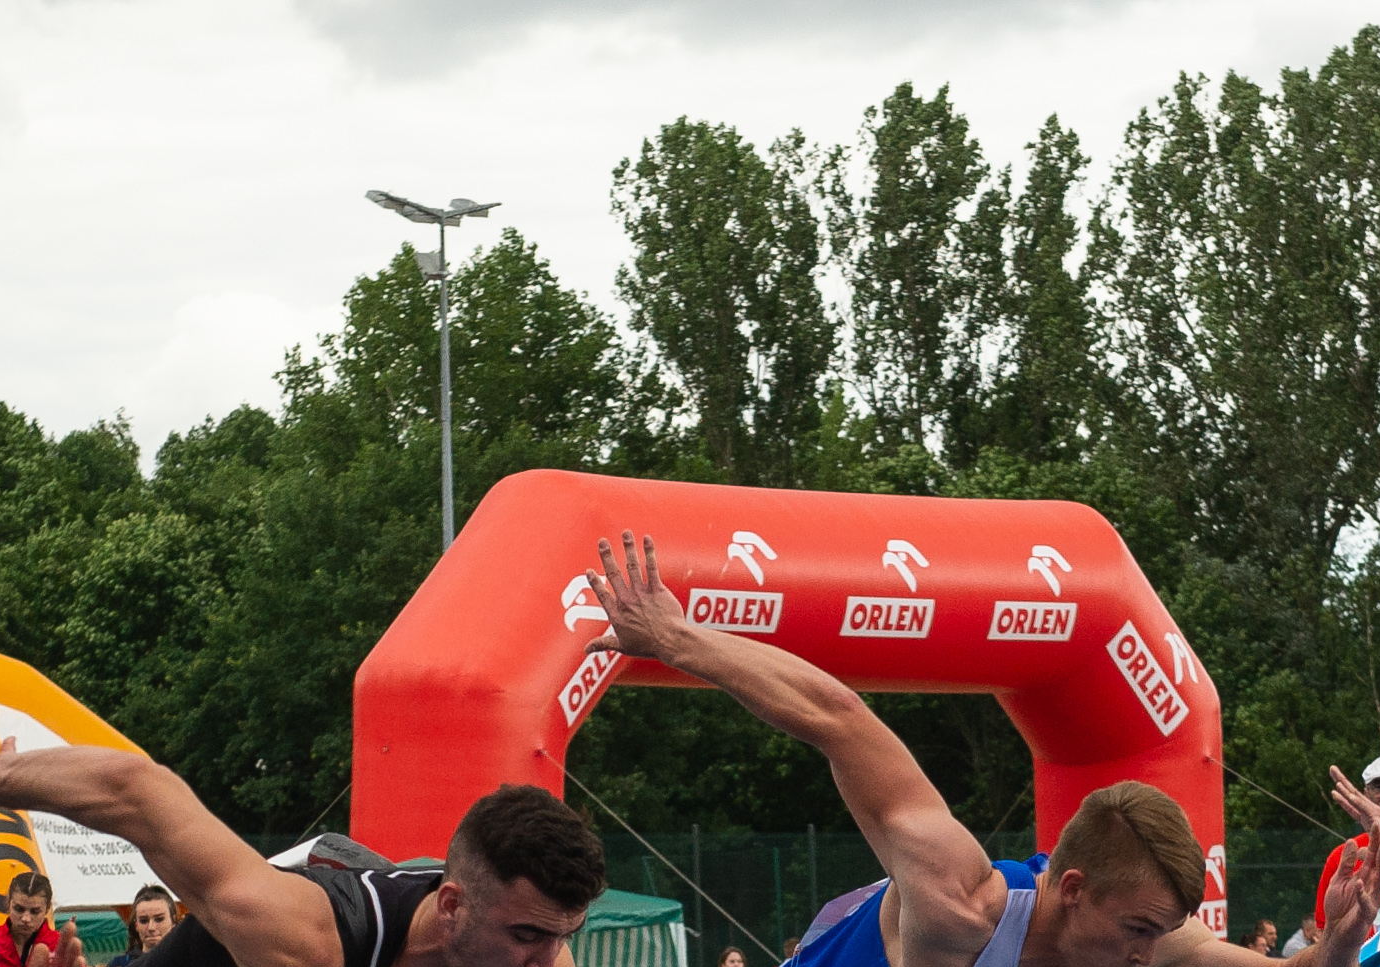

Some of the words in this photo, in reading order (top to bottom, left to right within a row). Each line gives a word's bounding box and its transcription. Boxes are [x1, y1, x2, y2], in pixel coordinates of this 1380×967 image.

[693, 596, 776, 627] ORLEN
[850, 603, 928, 632] ORLEN
[997, 608, 1071, 635] ORLEN
[567, 649, 617, 713] ORL
[1117, 633, 1180, 726] ORLEN
